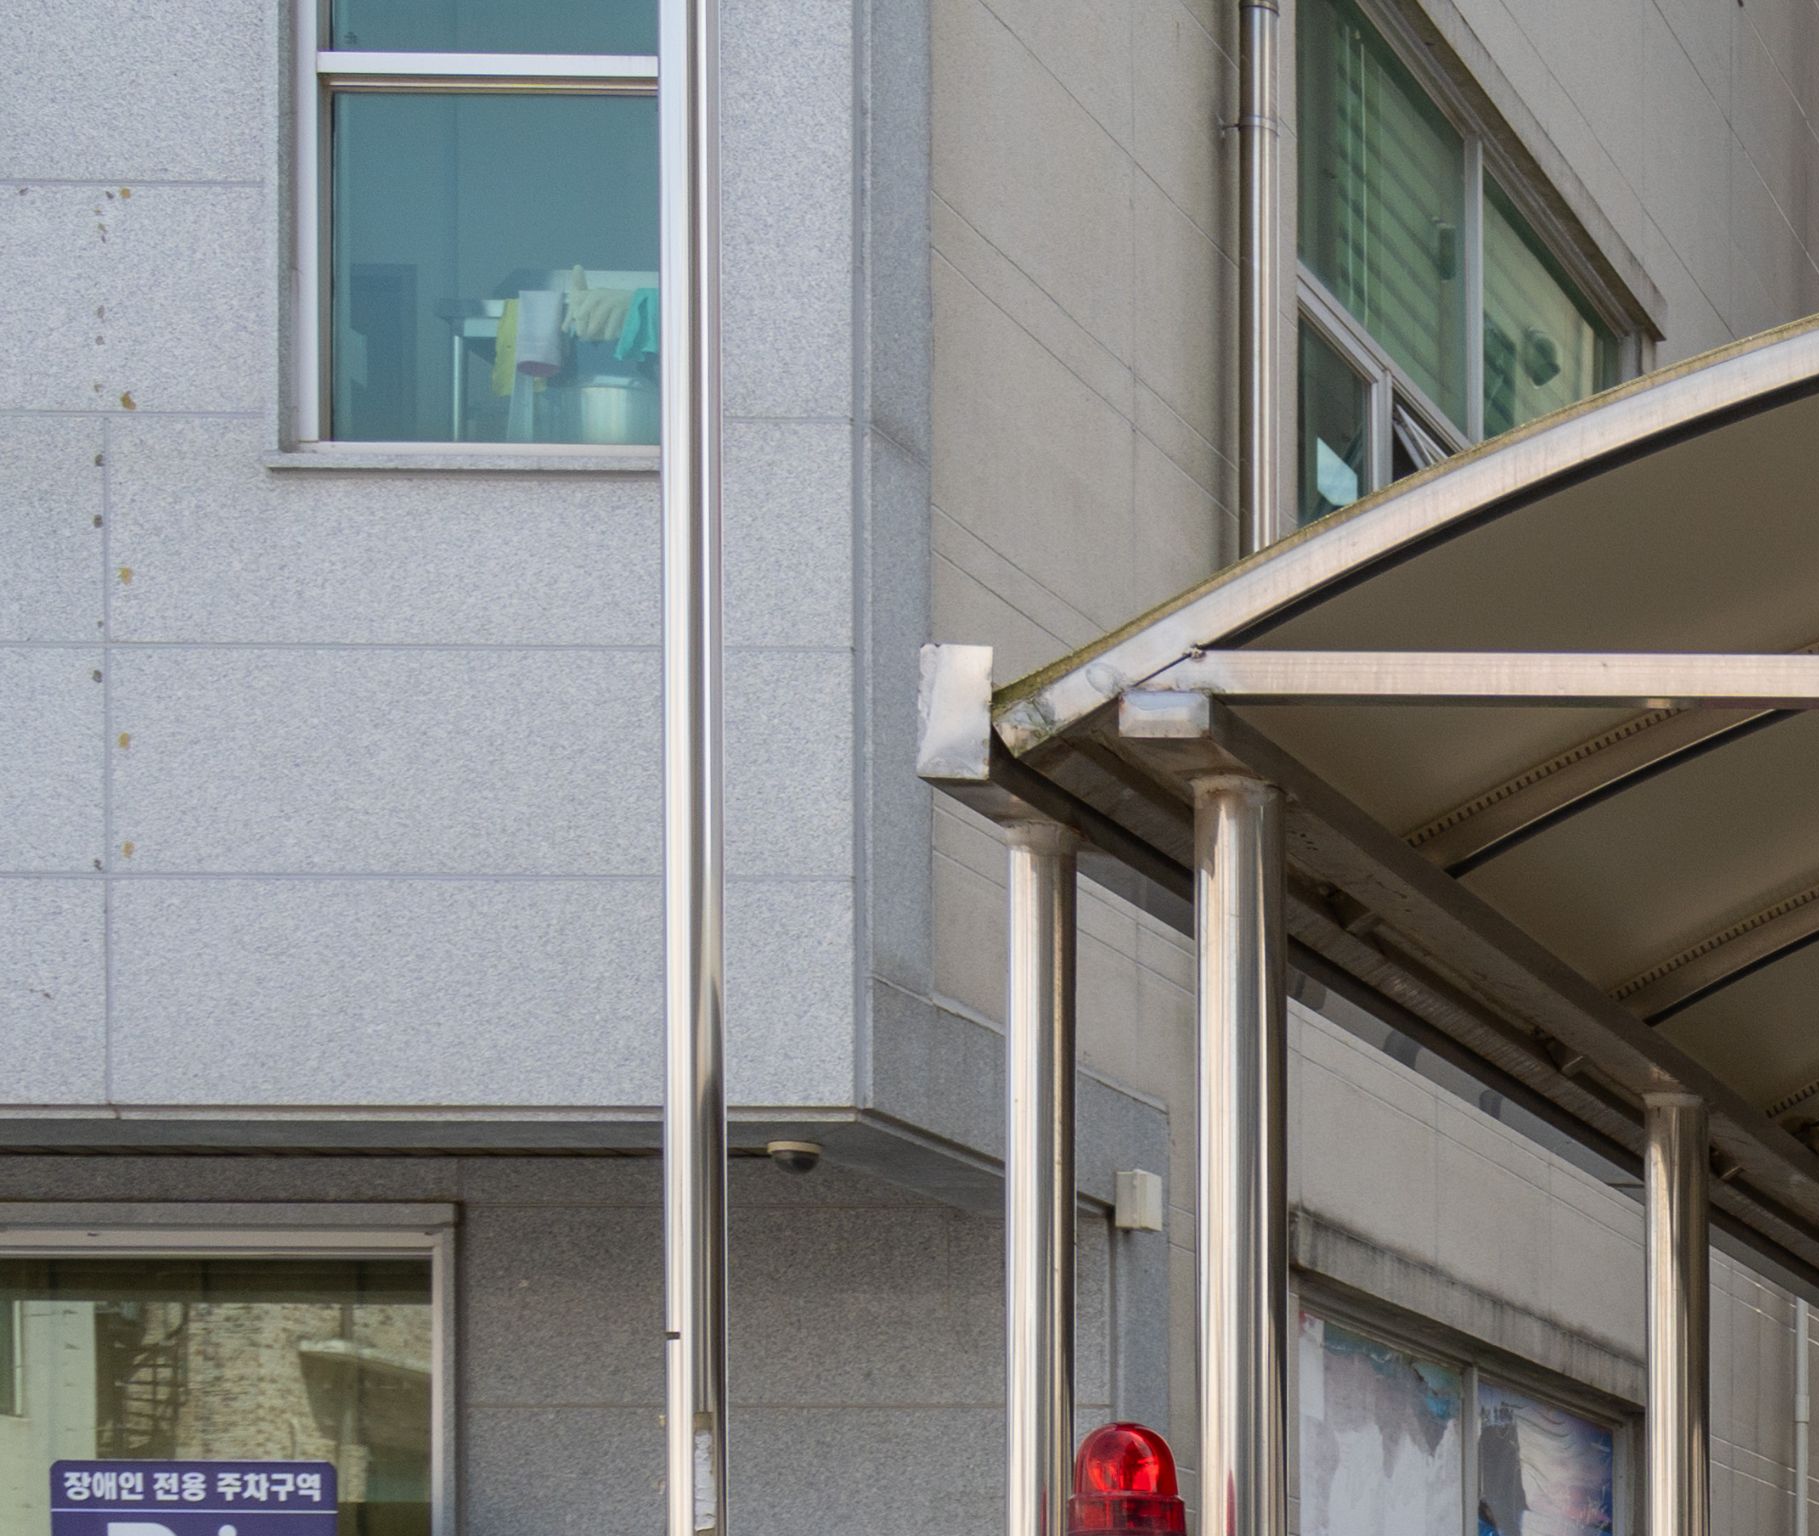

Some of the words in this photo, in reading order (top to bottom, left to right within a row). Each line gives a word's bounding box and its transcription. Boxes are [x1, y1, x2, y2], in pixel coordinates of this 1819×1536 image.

[65, 1472, 144, 1501] 장애인
[154, 1473, 206, 1502] 전용
[218, 1473, 321, 1502] 주차구역
